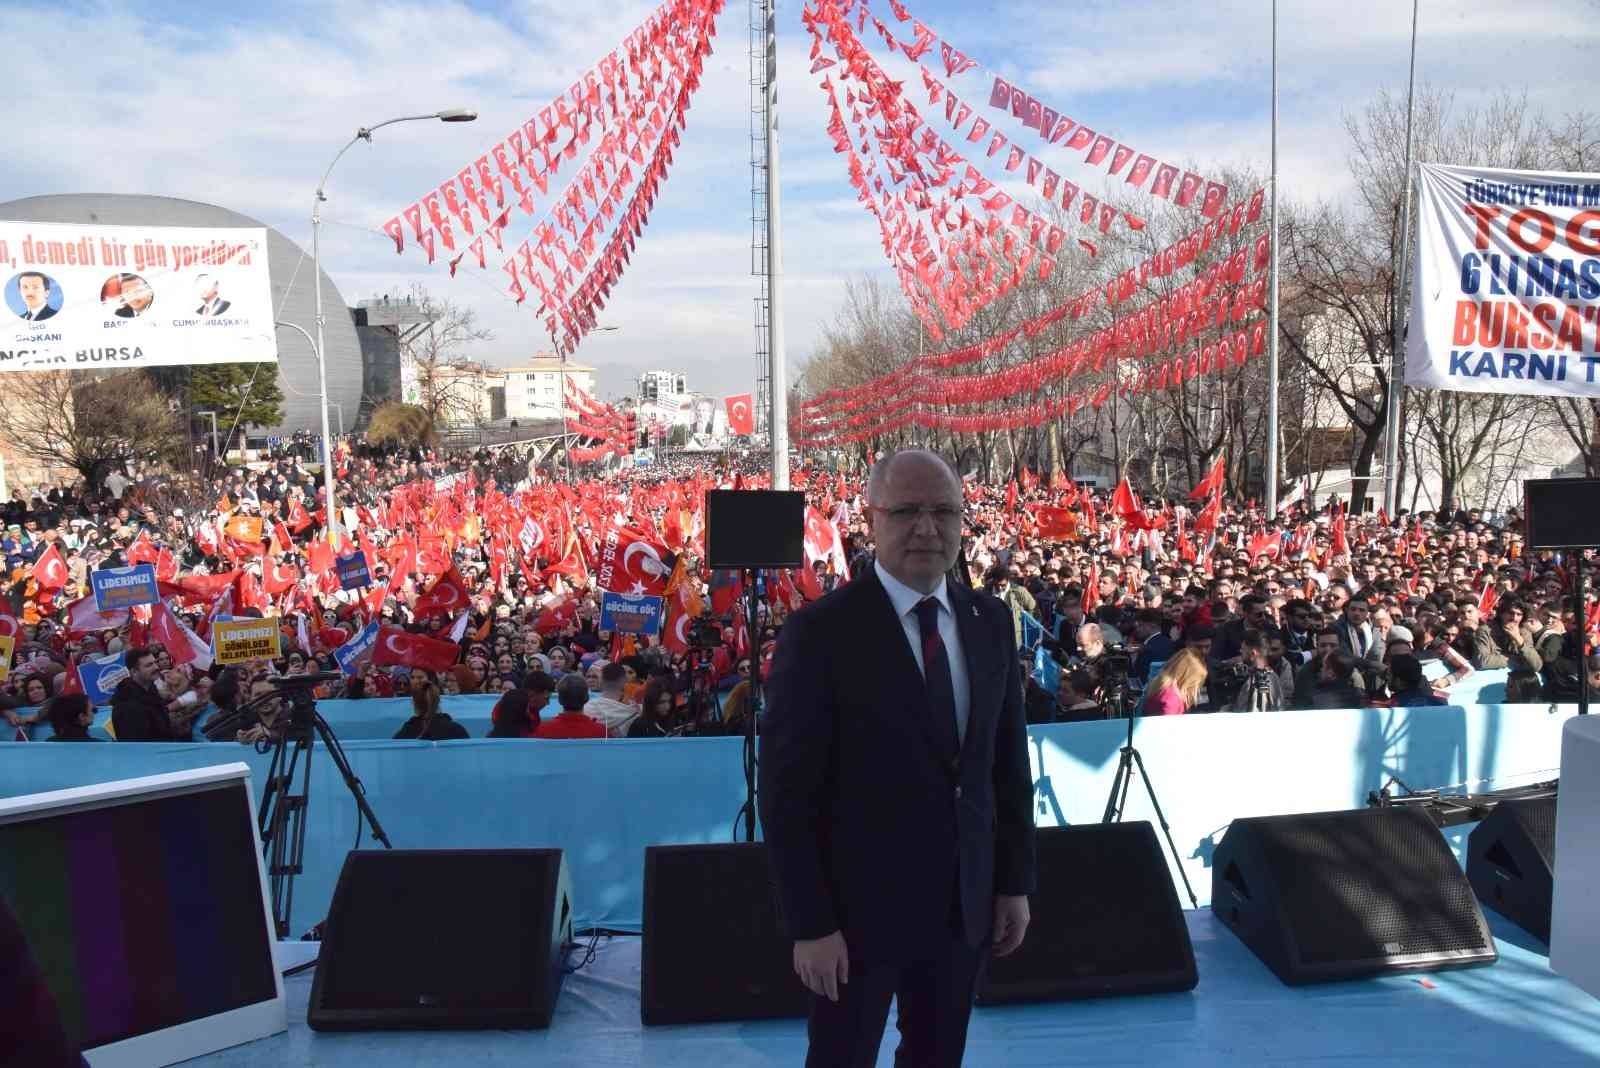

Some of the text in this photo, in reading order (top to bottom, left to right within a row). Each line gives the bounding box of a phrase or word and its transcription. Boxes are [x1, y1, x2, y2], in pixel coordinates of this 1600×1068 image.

[1462, 178, 1579, 206] TÜRKİYE'NİN
[23, 234, 95, 265] demedi
[100, 237, 127, 266] bir
[134, 239, 167, 271] gün
[76, 347, 144, 363] BURSA
[1449, 350, 1567, 382] KARNI
